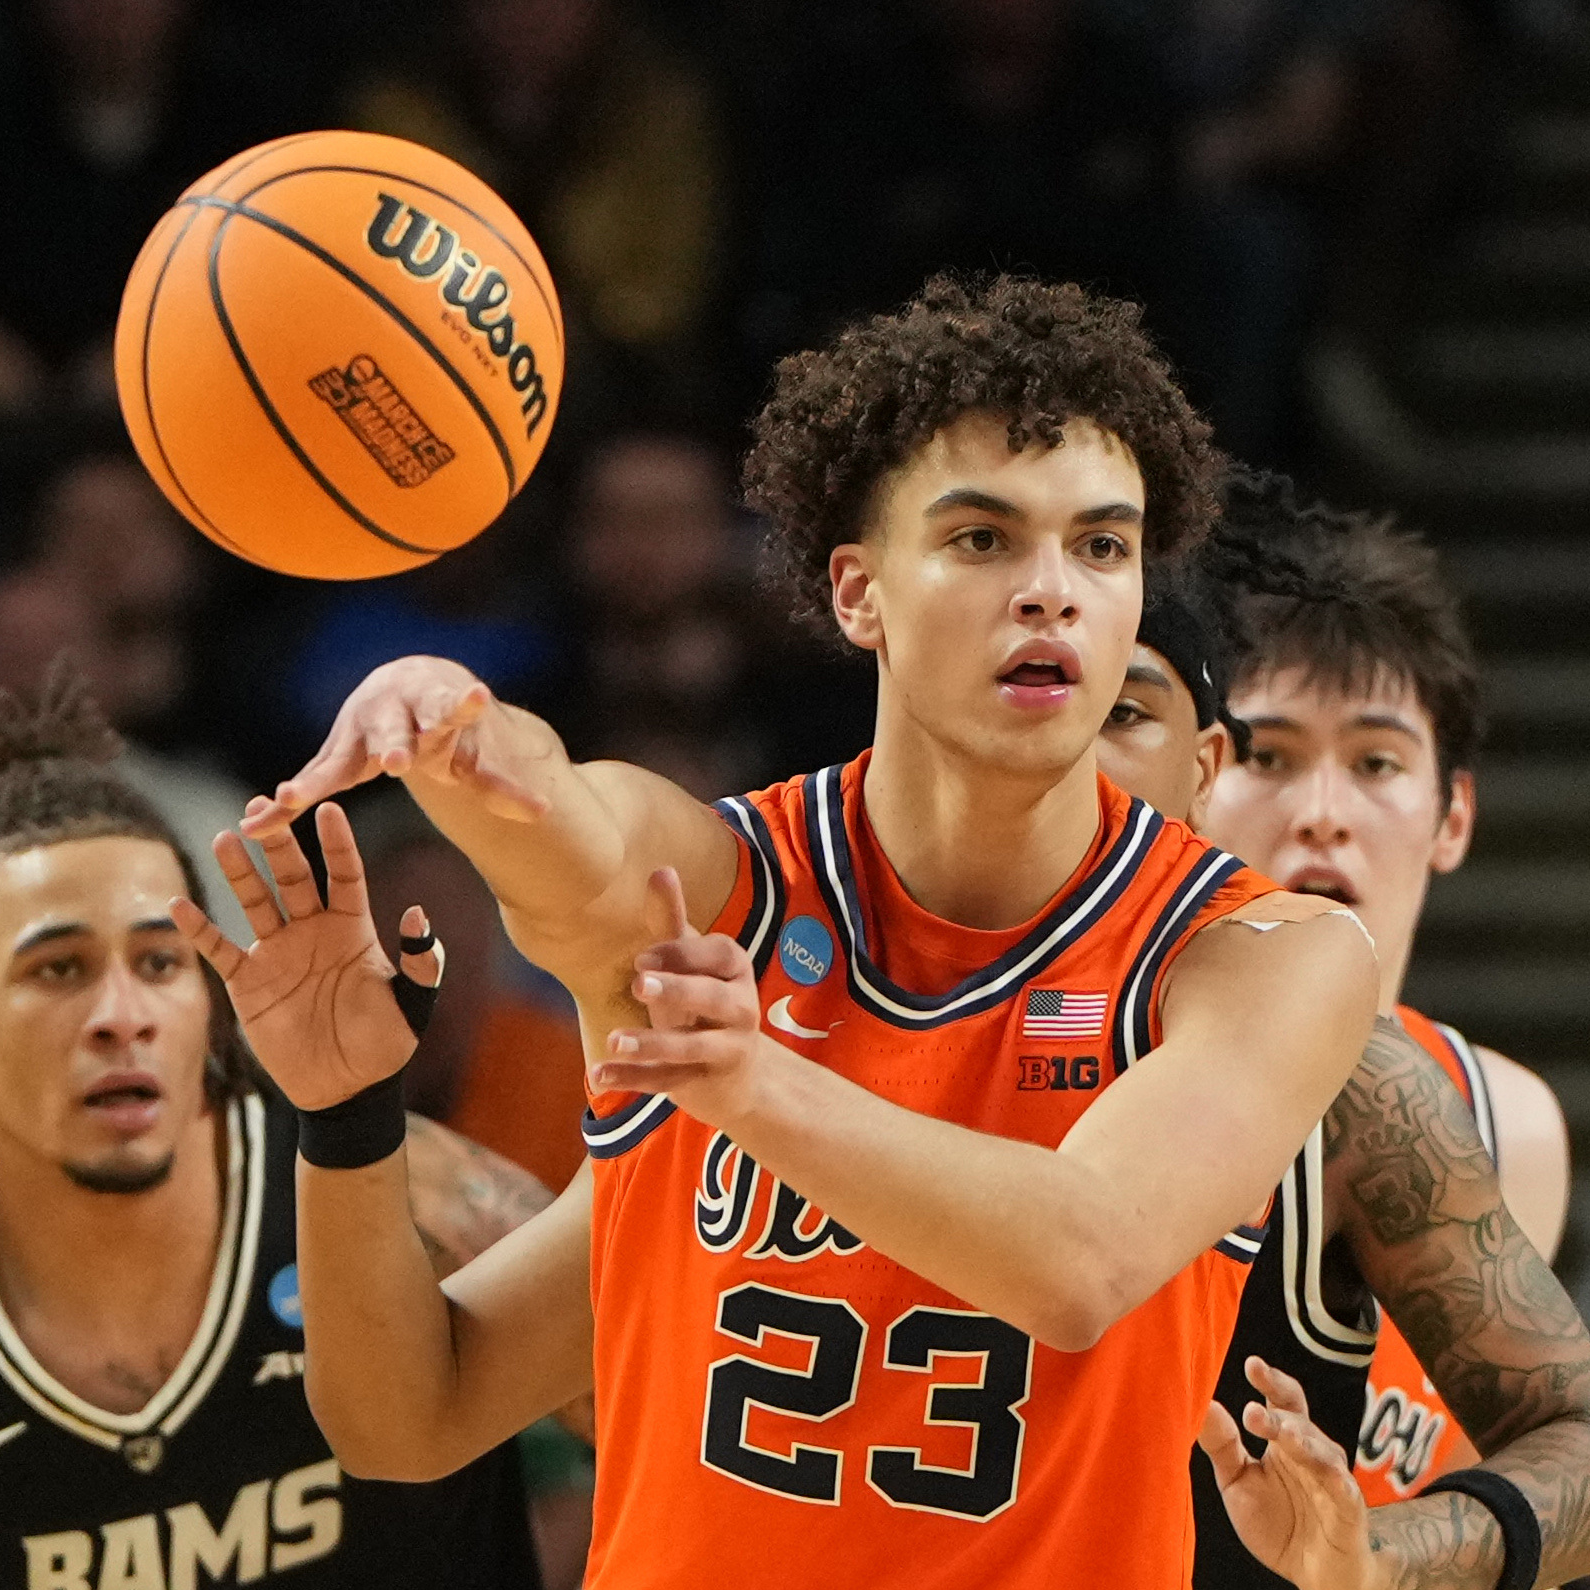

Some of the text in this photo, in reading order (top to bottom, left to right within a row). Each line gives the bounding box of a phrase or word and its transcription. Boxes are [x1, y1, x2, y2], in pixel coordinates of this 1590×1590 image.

[364, 191, 548, 441] Wilson
[350, 398, 430, 486] MADNESS
[361, 375, 429, 445] MARCH
[783, 937, 825, 979] NCAA
[700, 1280, 1034, 1524] 23
